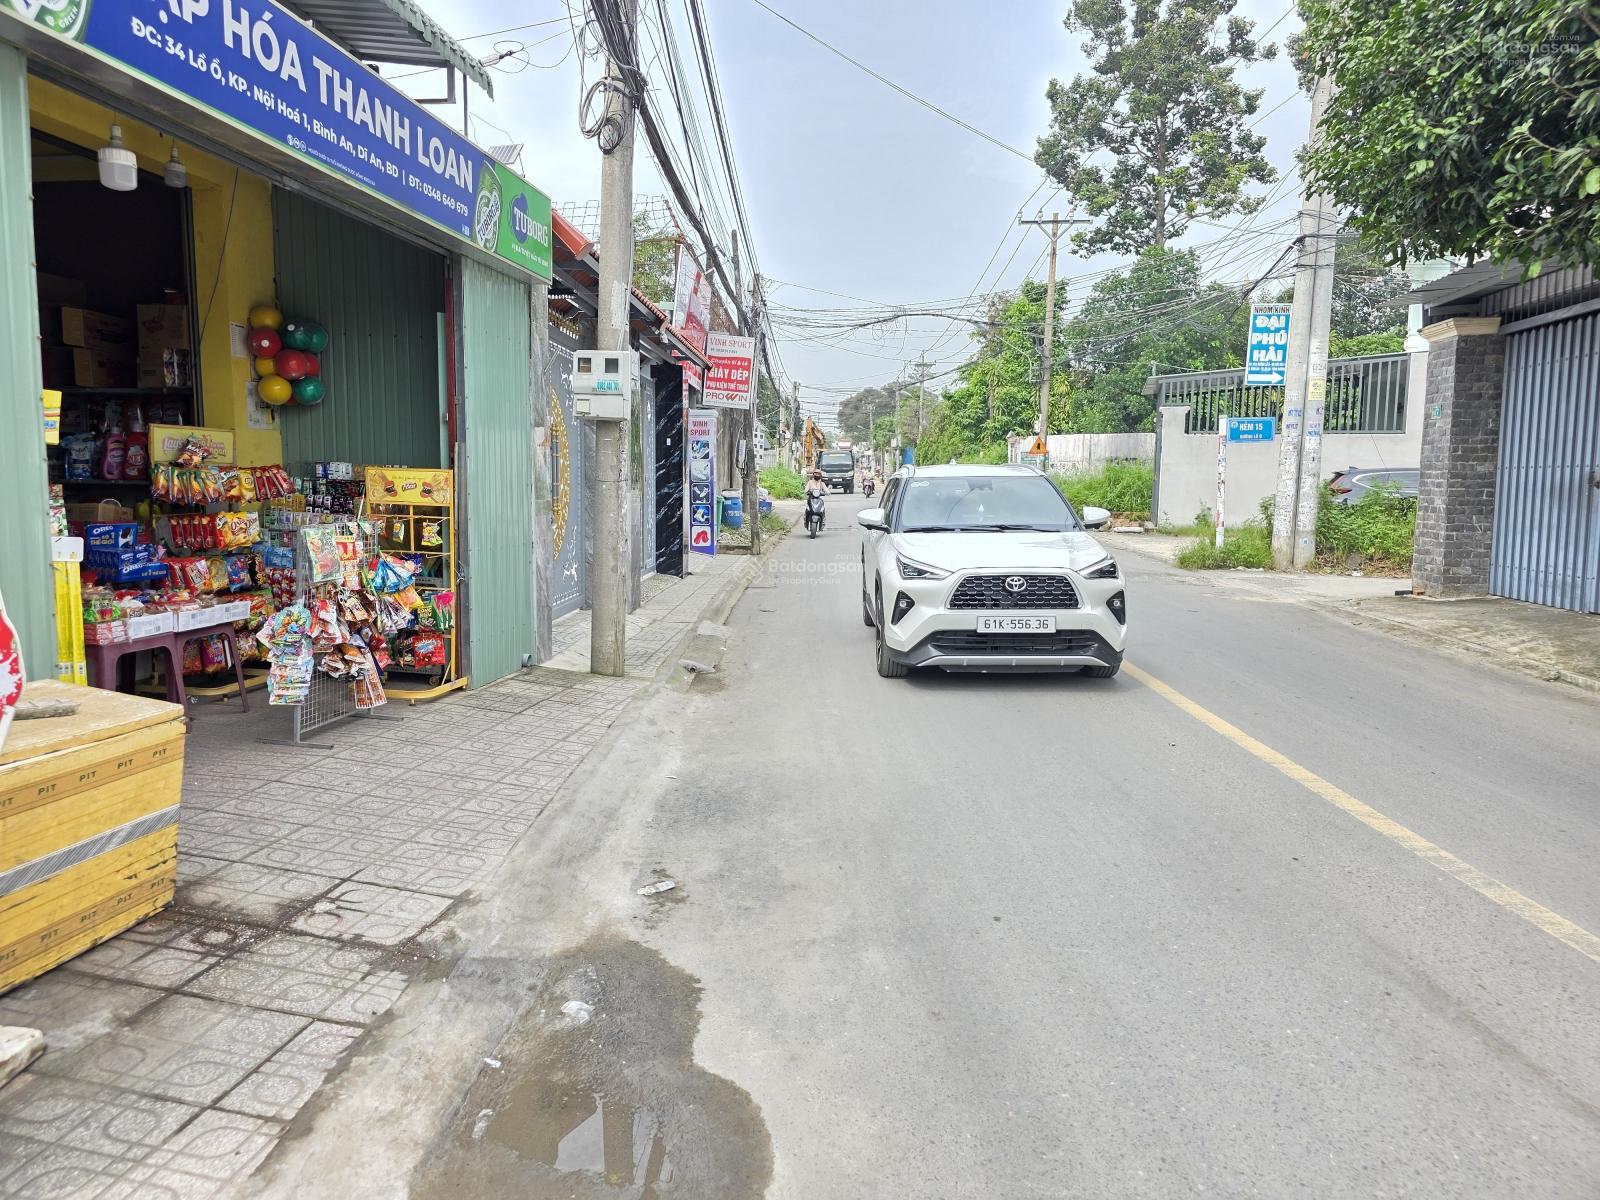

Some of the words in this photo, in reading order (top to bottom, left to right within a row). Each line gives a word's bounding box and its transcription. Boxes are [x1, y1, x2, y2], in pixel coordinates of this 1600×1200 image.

[222, 0, 307, 93] HÓA
[312, 56, 411, 156] THANH
[417, 125, 473, 194] LOAN
[131, 16, 162, 48] ĐC:
[165, 34, 186, 61] 34
[228, 70, 251, 97] KP.
[253, 84, 275, 111] Nội
[277, 98, 301, 125] Hoá
[302, 112, 311, 132] 1,
[313, 118, 338, 145] Bình
[339, 135, 356, 157] An,
[357, 144, 368, 162] Dĩ
[369, 153, 385, 173] An,
[386, 161, 399, 178] BD
[408, 174, 422, 192] ĐT:
[423, 182, 441, 202] 0348
[442, 193, 456, 210] 649
[456, 201, 469, 217] 679
[513, 206, 549, 248] TUBORG
[1255, 315, 1286, 331] ĐẠI
[728, 339, 753, 349] SPORT
[1251, 330, 1288, 346] PHÚ
[1252, 345, 1284, 361] HẢI
[708, 366, 730, 379] GIÀY
[730, 367, 749, 381] DÉP
[690, 428, 710, 436] SPORT
[1255, 423, 1264, 431] 15
[92, 525, 114, 535] OREO
[122, 563, 143, 574] OREO
[984, 619, 1049, 630] 61K-556.36
[0, 797, 14, 807] IT
[37, 783, 57, 796] PIT
[79, 770, 97, 782] PIT
[117, 758, 134, 770] PIT
[152, 748, 168, 758] PIT
[40, 928, 60, 943] PIT
[80, 910, 98, 923] PIT
[116, 893, 133, 906] PIT
[150, 877, 166, 889] PIT
